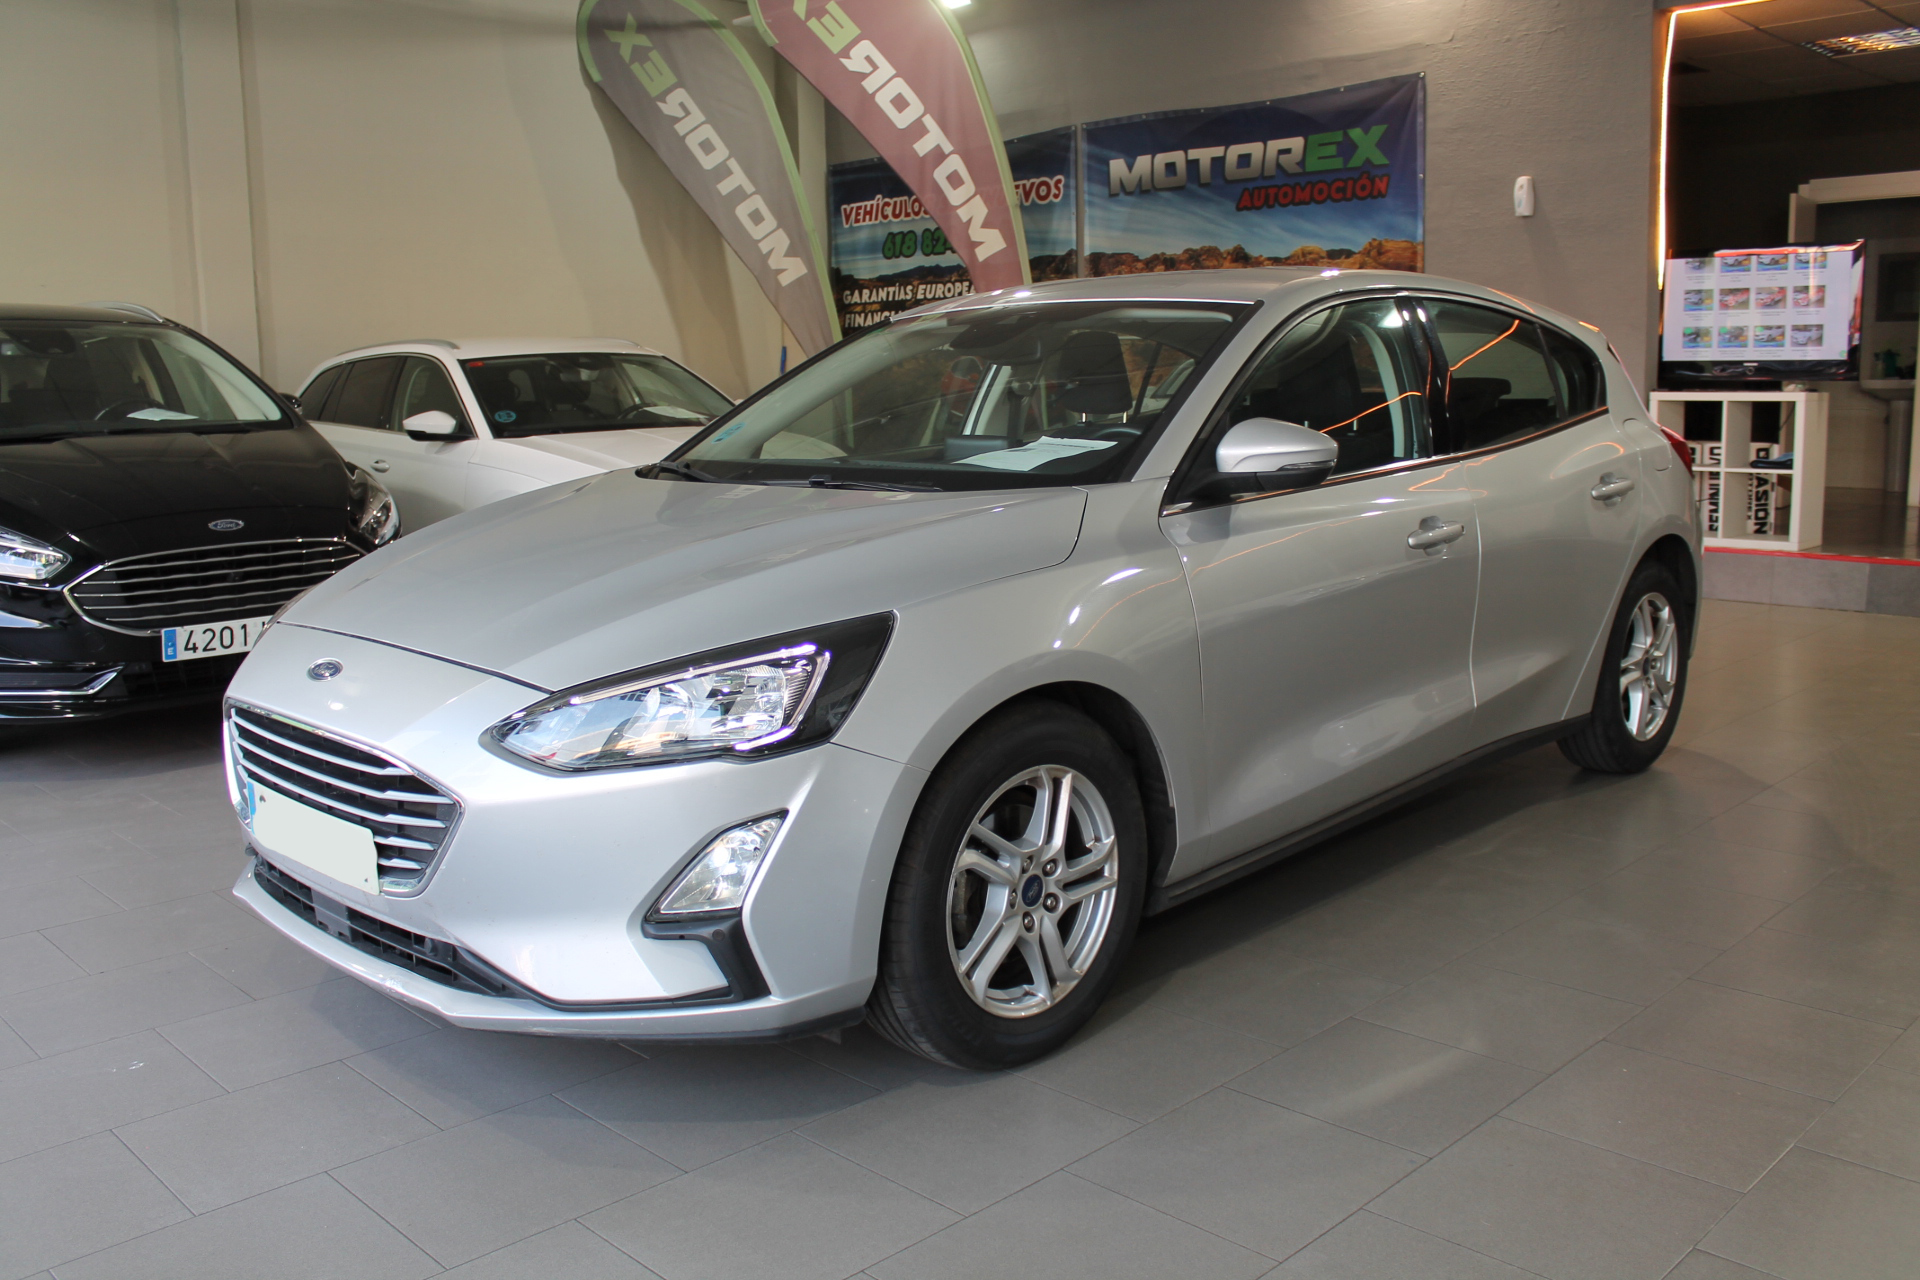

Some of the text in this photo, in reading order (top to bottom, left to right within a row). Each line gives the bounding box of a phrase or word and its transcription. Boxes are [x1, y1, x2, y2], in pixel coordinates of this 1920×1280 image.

[1109, 124, 1390, 196] MOTOREX
[1237, 173, 1390, 210] AUTOMOCIÓN
[882, 229, 918, 259] 618
[843, 283, 914, 305] GARANTÍAS
[184, 624, 247, 653] 4201
